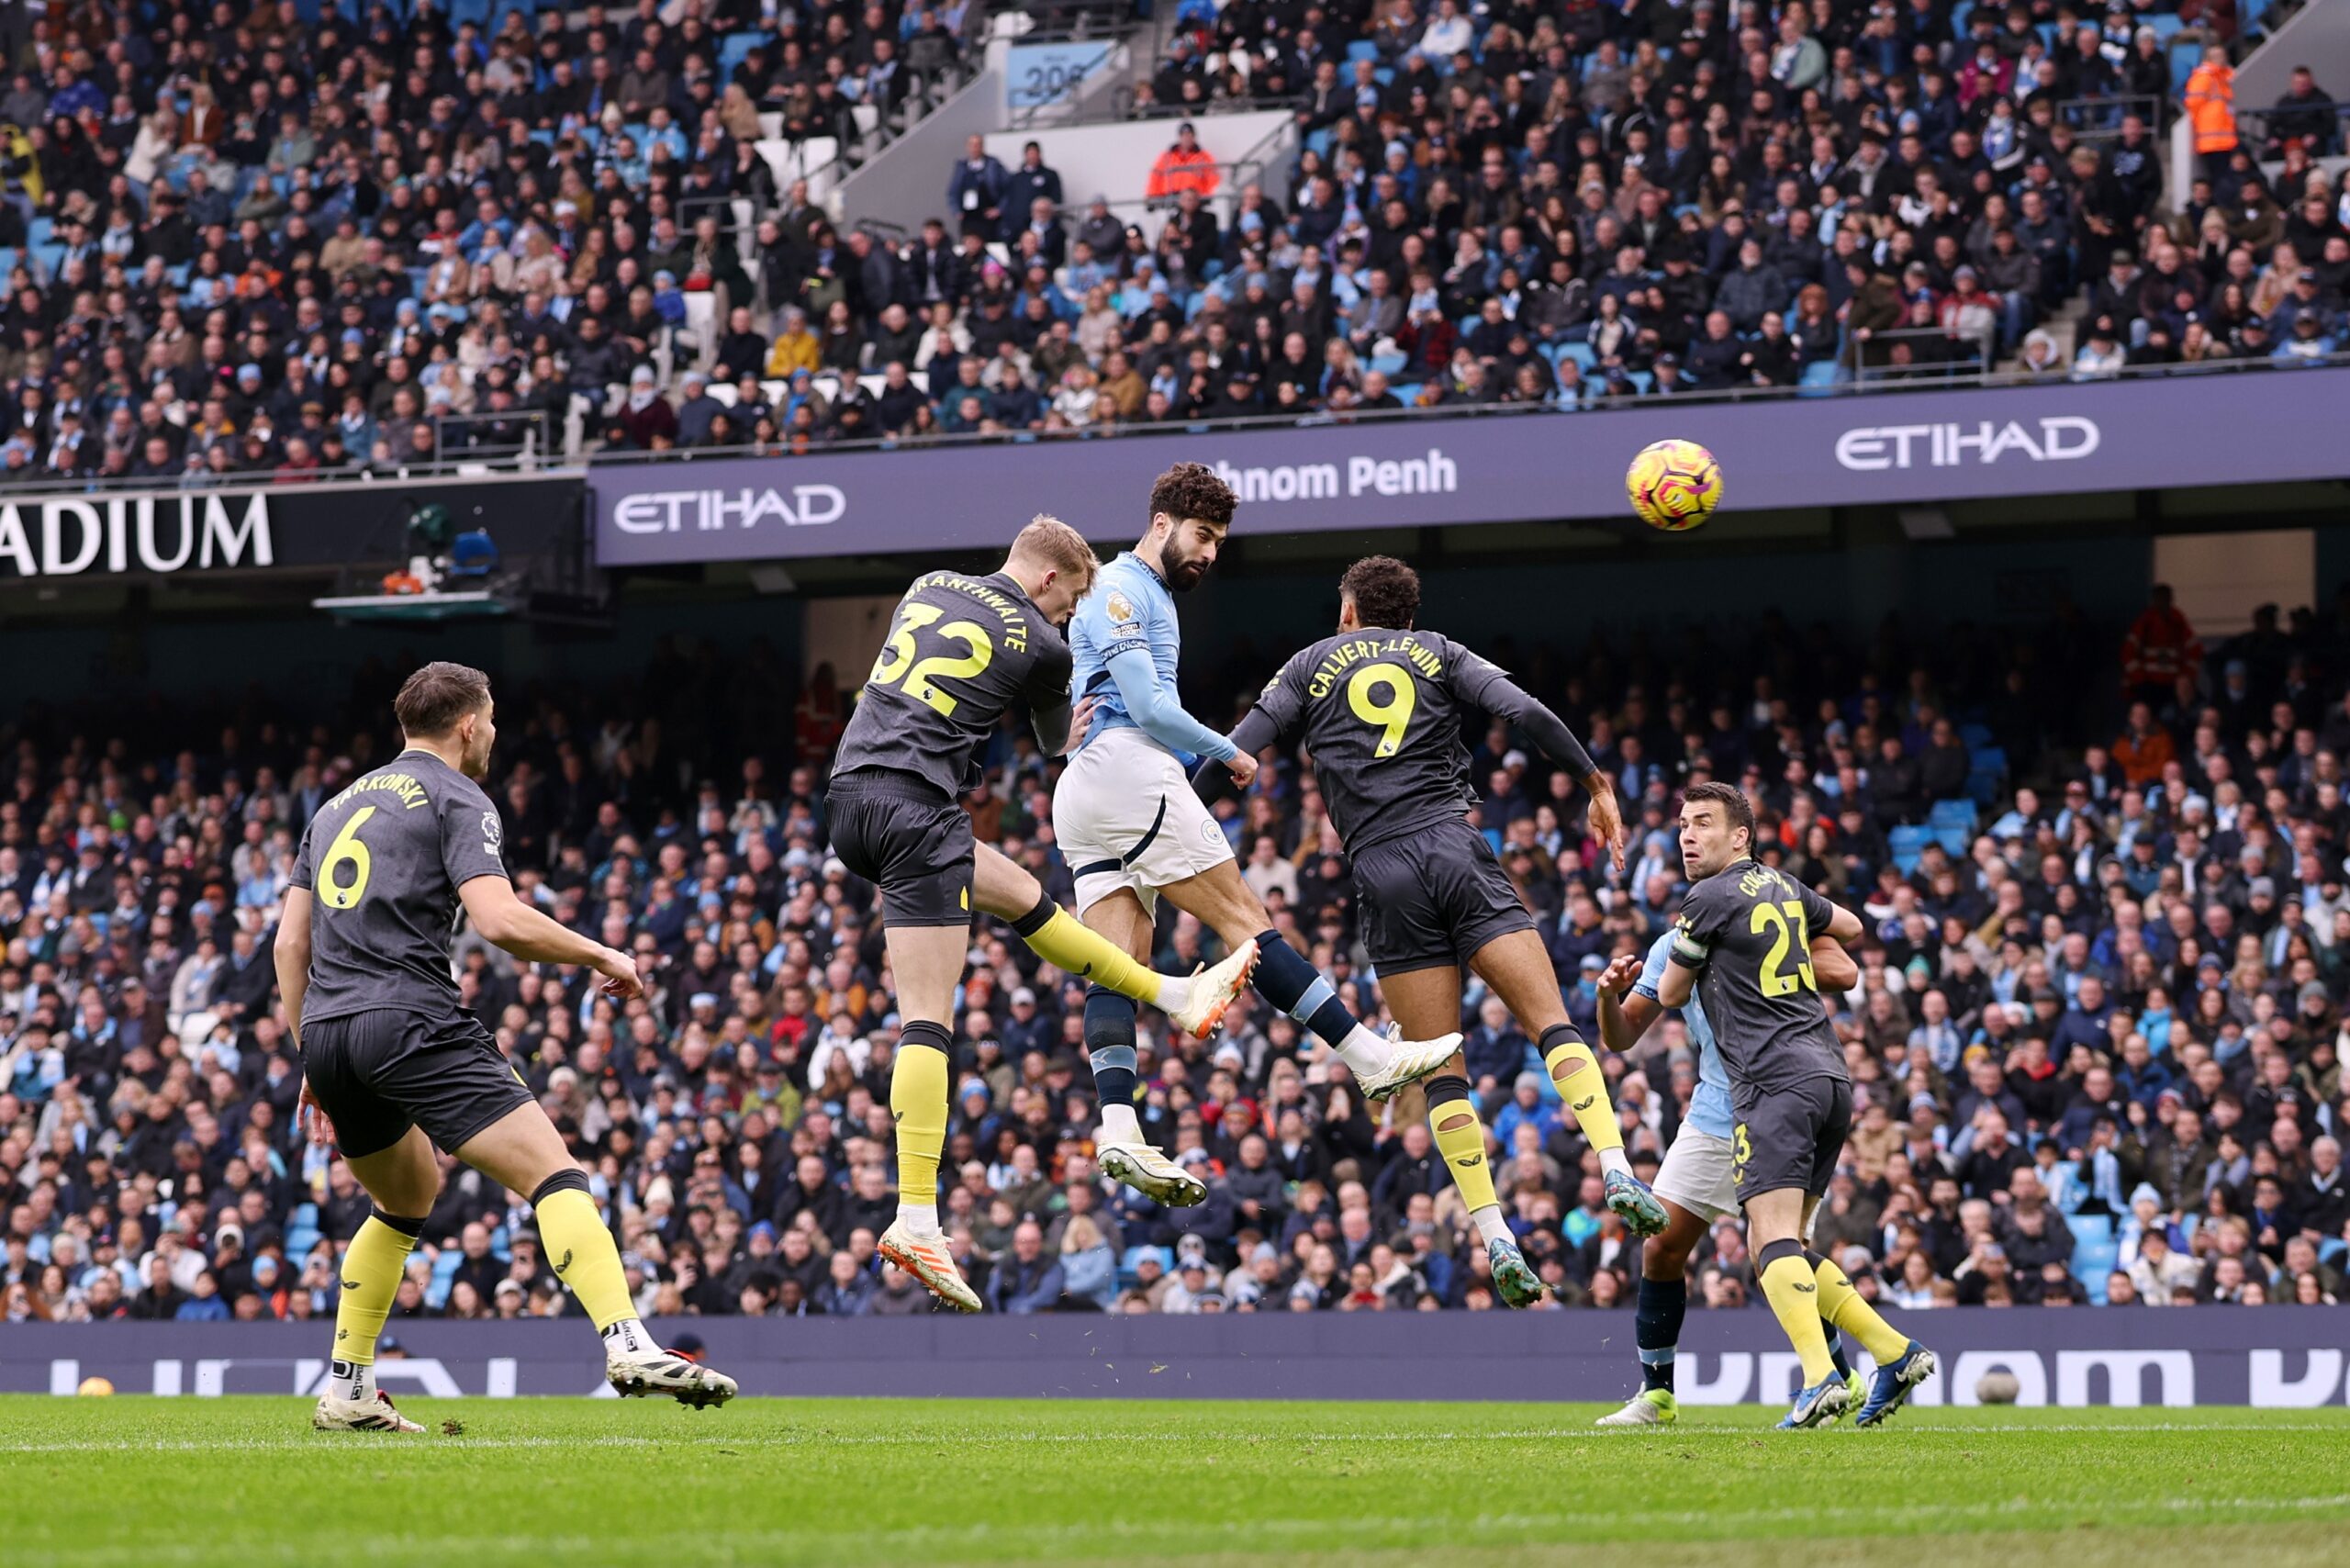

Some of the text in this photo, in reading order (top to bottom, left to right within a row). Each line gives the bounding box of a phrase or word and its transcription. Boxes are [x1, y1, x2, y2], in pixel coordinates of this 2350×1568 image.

[1206, 448, 1458, 502] hnom Penh
[1835, 416, 2100, 471] ETIHAD
[0, 492, 274, 577] ADIUM
[613, 484, 846, 534] ETIHAD
[869, 602, 993, 717] 32
[1308, 636, 1444, 698] CALVERT-LEWIN
[1347, 663, 1416, 758] 9
[330, 774, 429, 810] TARKOWSKI
[318, 805, 377, 909] 6
[1750, 900, 1818, 998] 23
